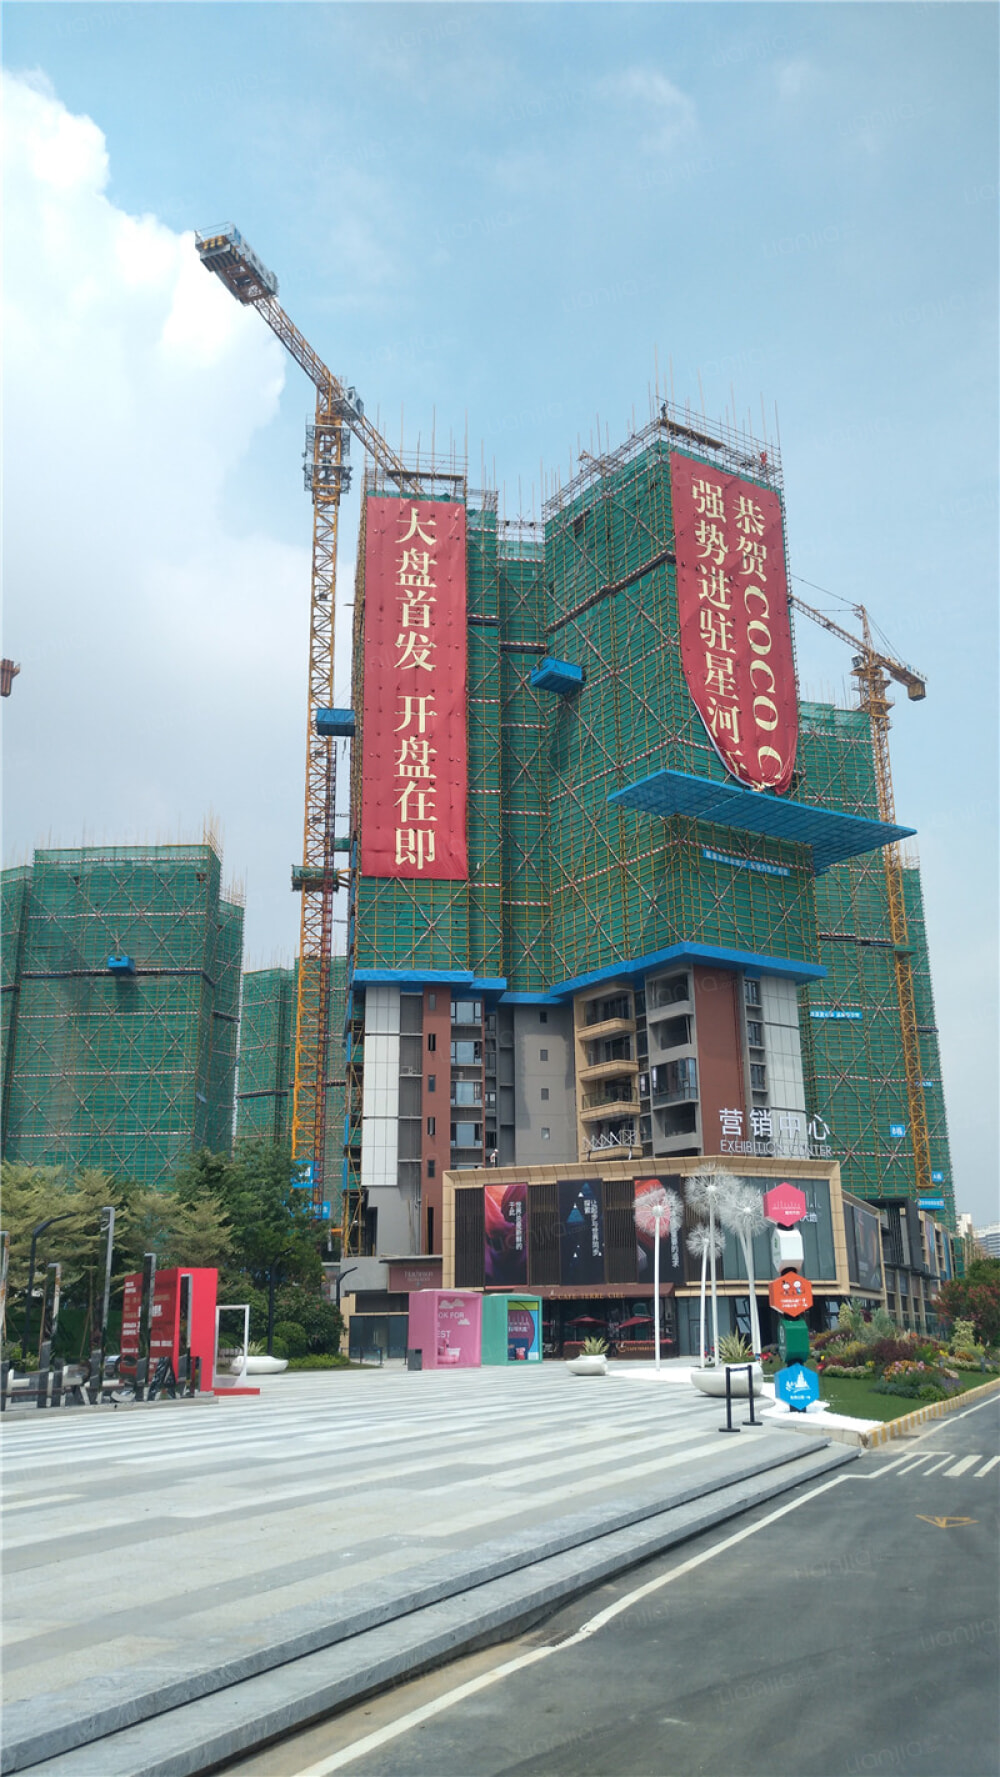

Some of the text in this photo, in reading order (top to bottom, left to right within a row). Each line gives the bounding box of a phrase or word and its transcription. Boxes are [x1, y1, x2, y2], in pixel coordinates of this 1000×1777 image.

[393, 507, 438, 870] 大盘首发 开盘在即
[719, 1107, 831, 1141] 营销中心
[720, 1139, 833, 1158] EXHIBITION CENTER
[450, 1311, 465, 1319] FOR
